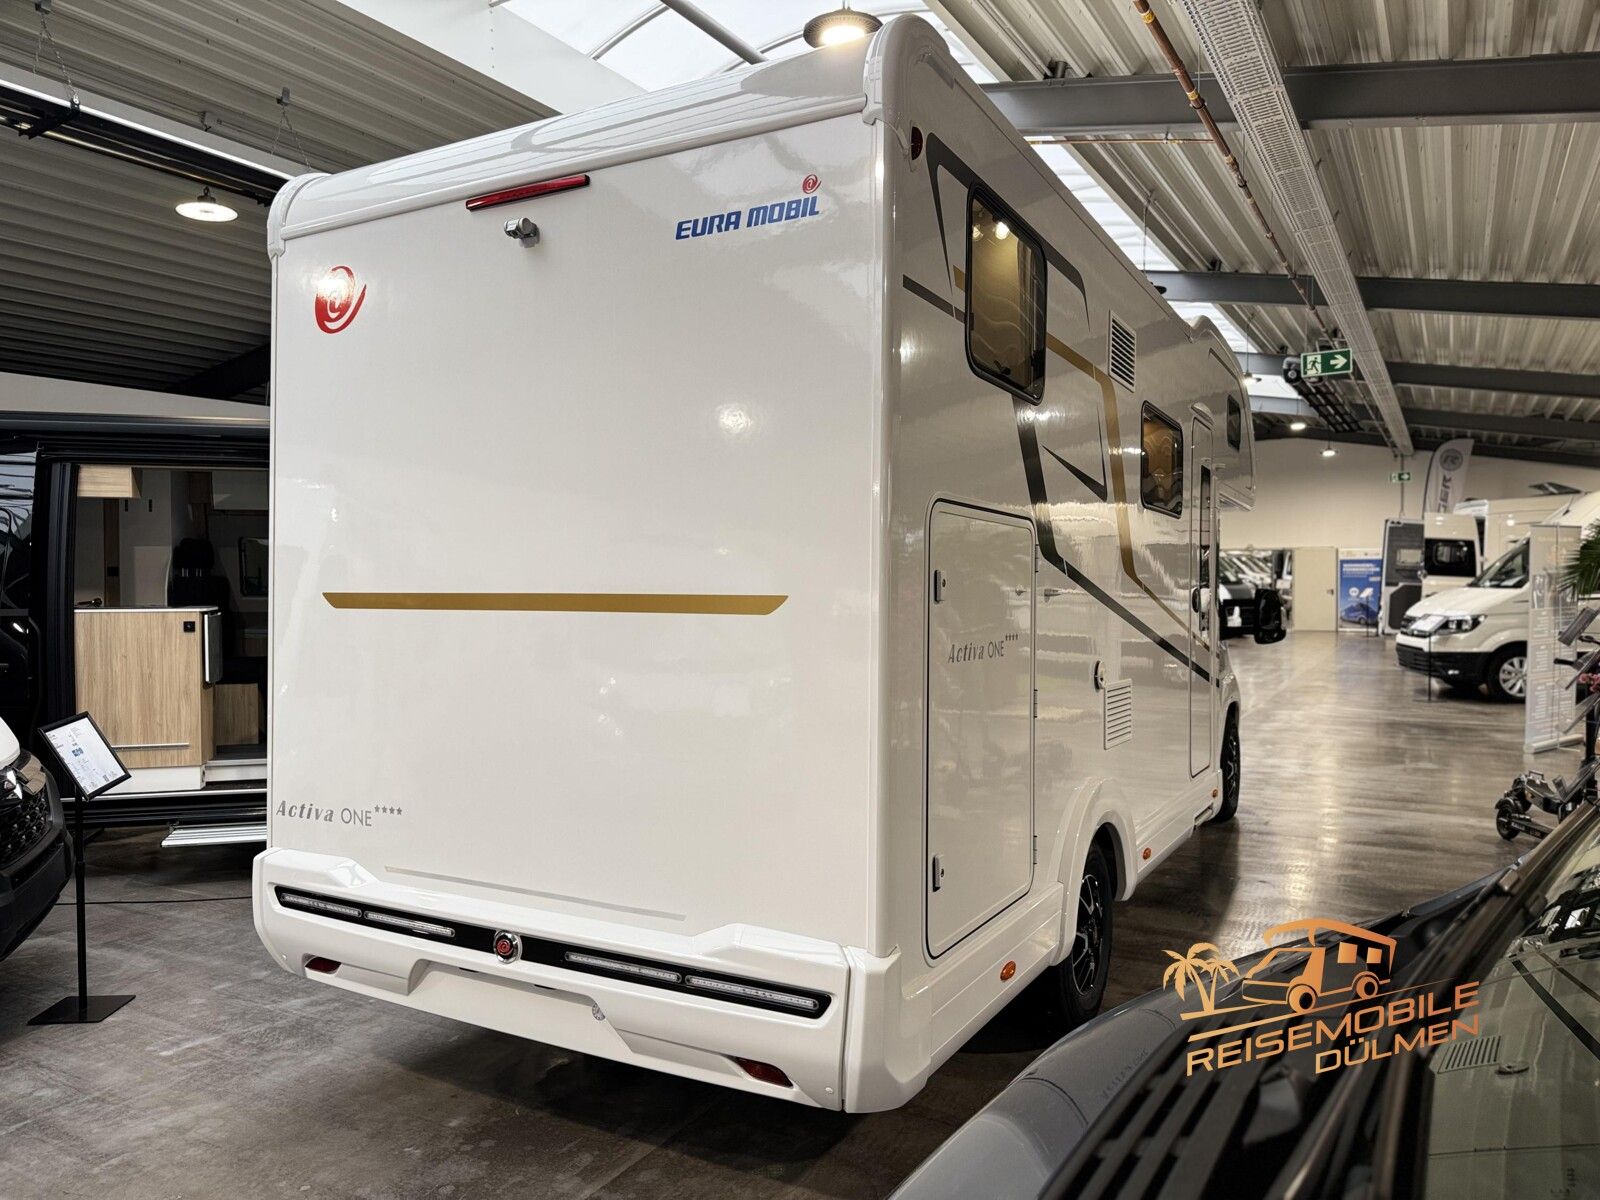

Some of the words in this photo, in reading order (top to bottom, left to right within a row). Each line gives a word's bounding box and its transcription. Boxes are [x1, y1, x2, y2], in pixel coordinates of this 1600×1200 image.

[675, 210, 742, 241] EURA
[746, 195, 820, 228] MOBIL
[946, 641, 985, 664] Activa
[275, 799, 335, 823] Activa
